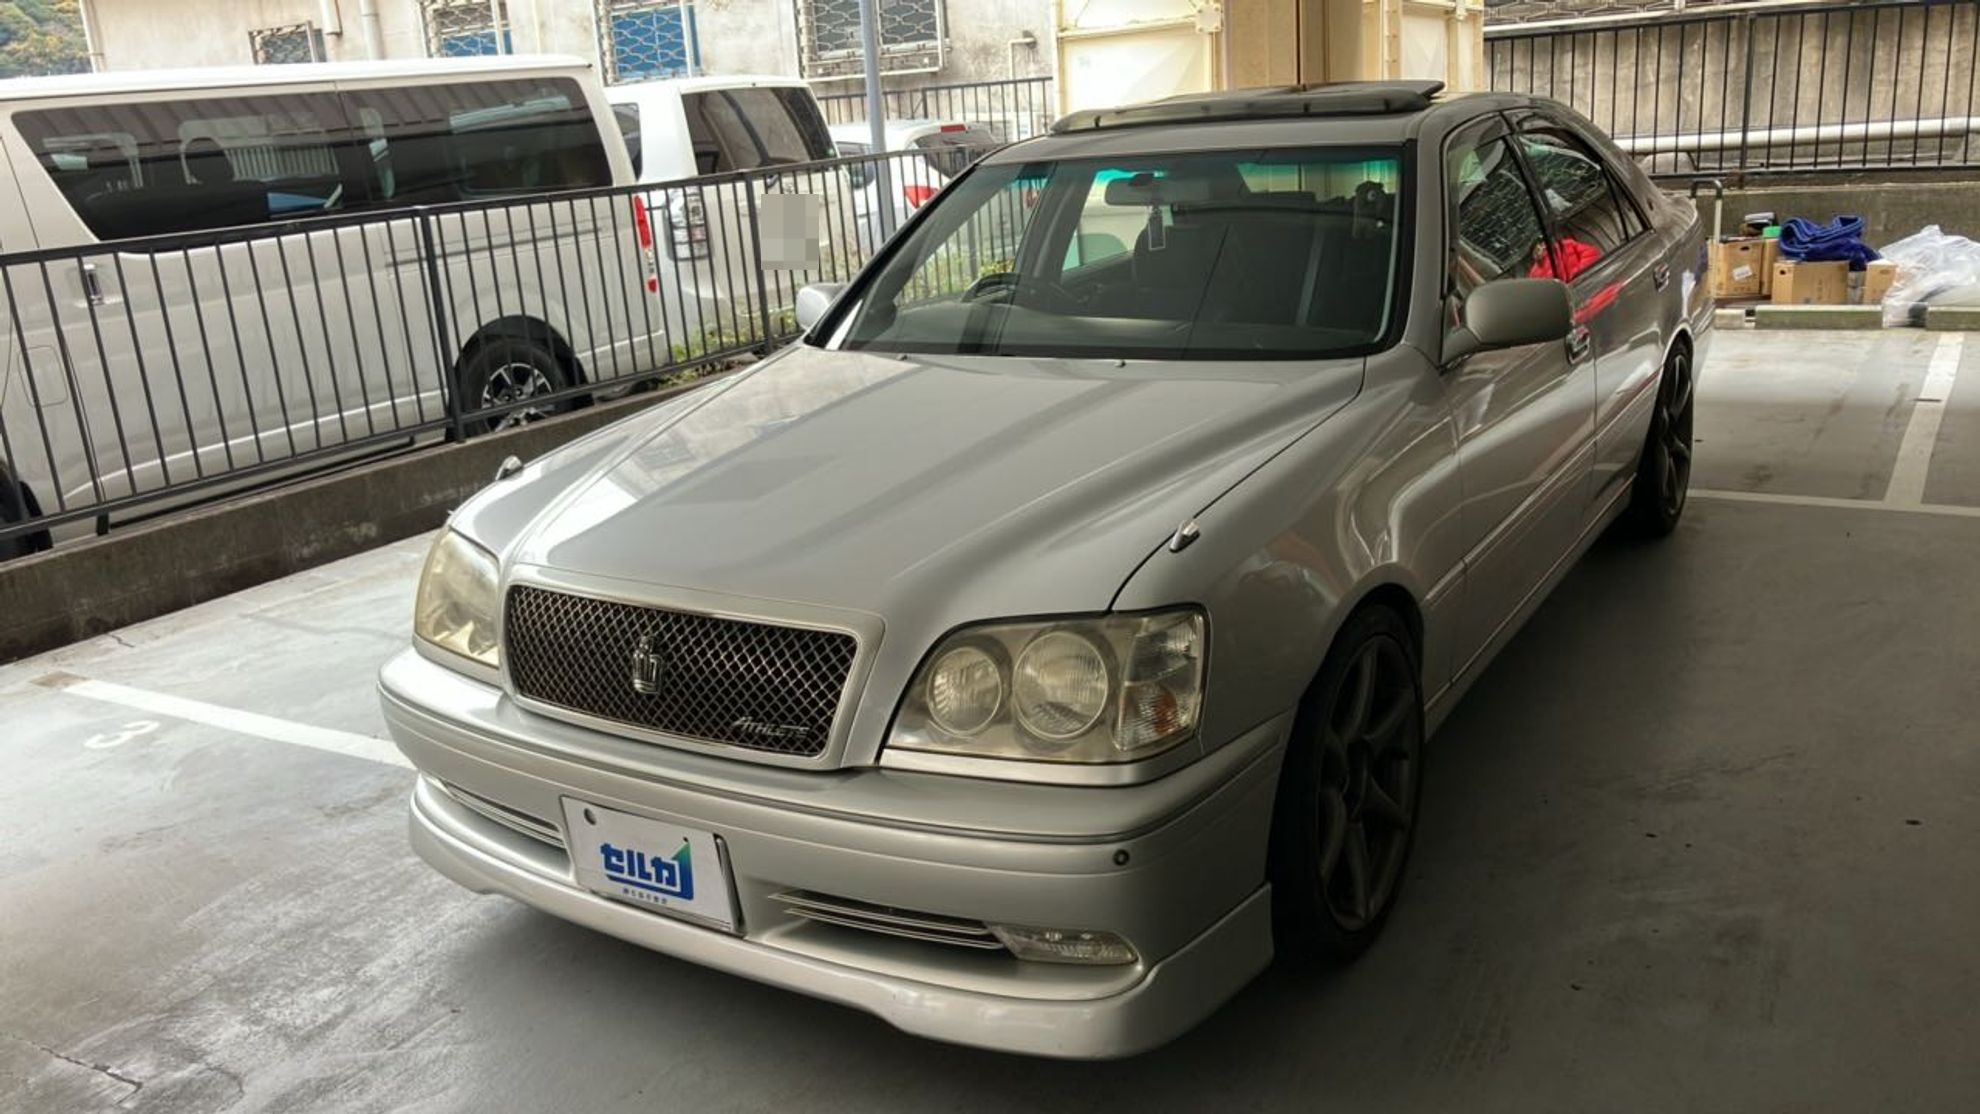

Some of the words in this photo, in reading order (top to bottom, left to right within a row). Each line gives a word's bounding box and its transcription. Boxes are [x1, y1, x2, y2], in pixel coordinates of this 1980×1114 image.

[84, 719, 161, 749] 3
[600, 843, 679, 888] セルカ
